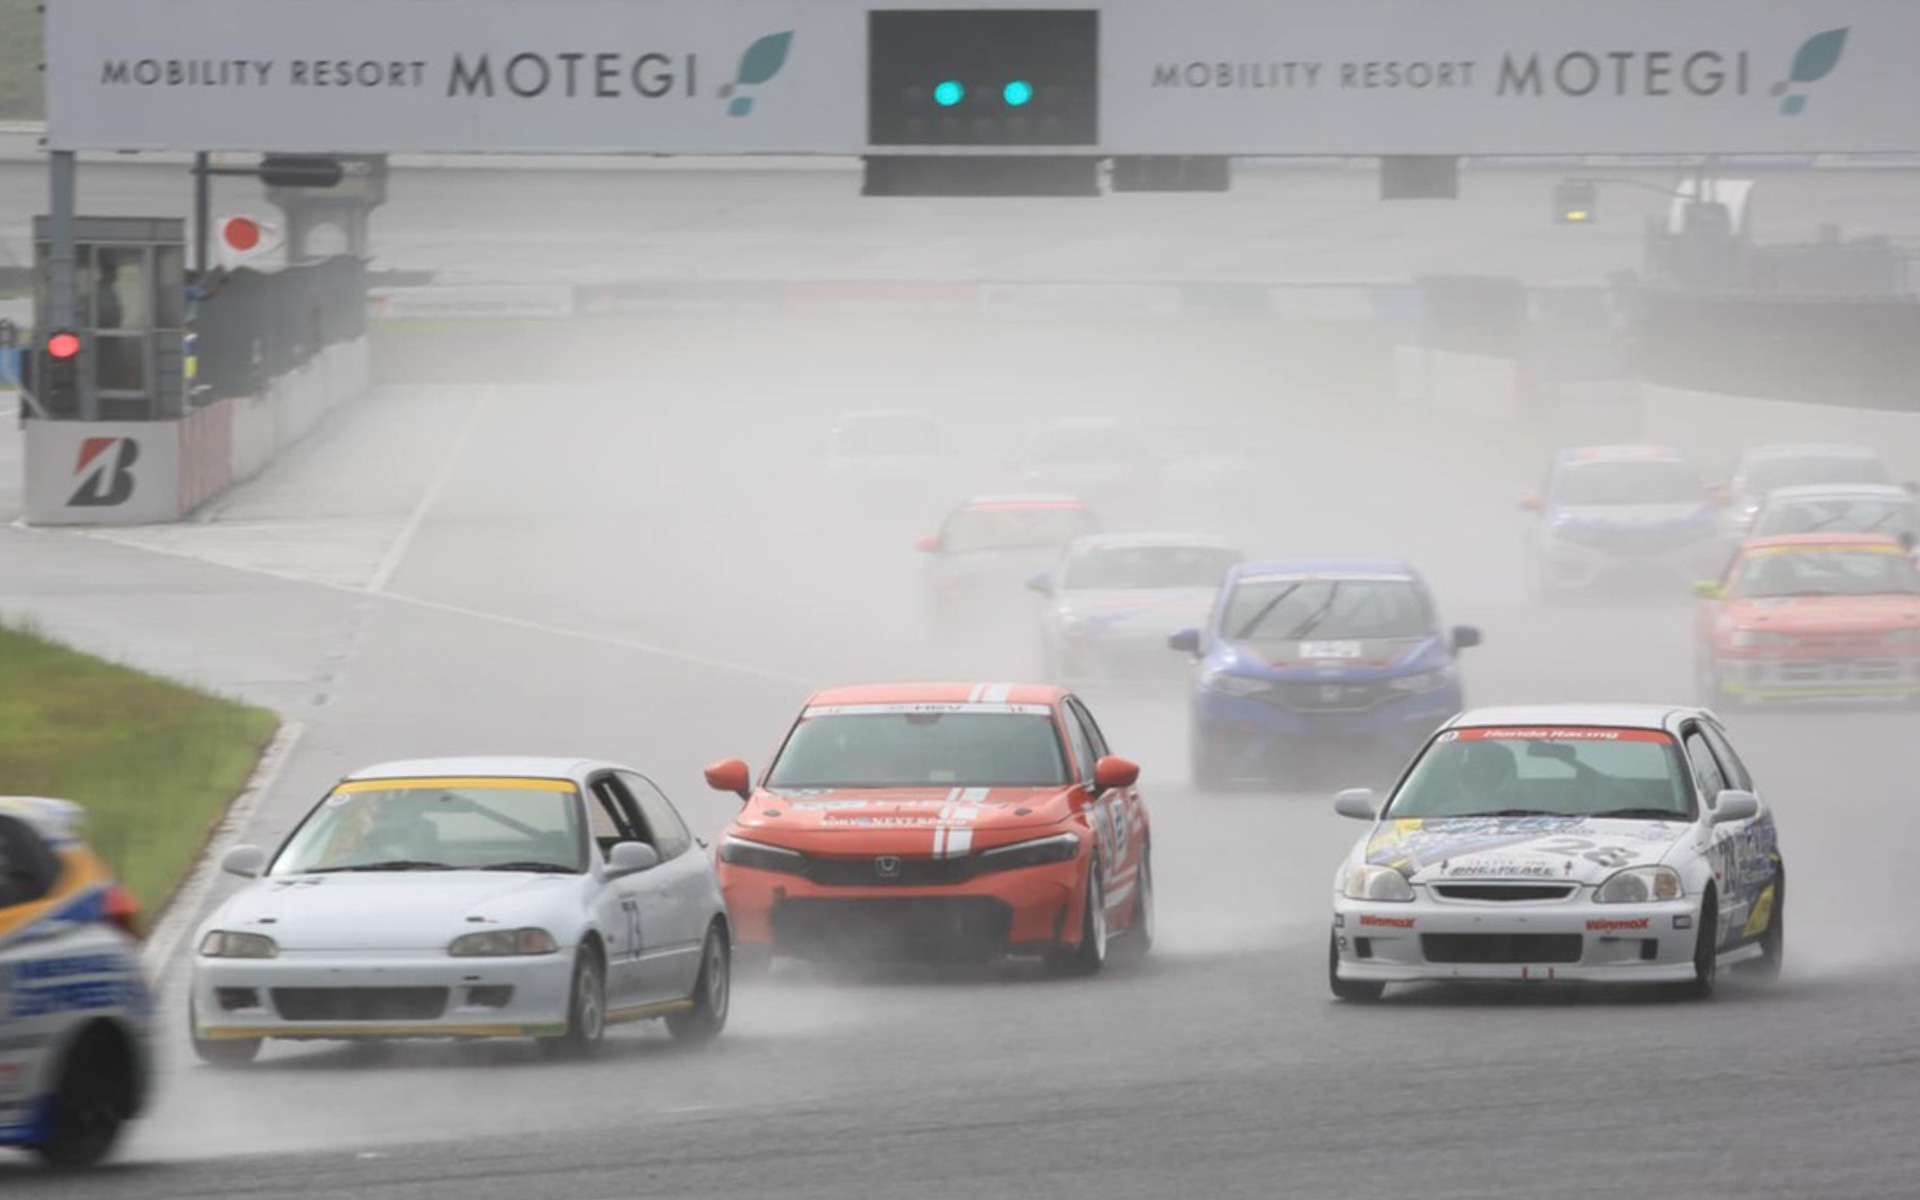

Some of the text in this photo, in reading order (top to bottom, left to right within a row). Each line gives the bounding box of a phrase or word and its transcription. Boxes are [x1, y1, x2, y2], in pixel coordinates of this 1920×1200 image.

[101, 53, 697, 98] MOBILITY RESORT MOTEGI
[1152, 51, 1749, 97] MOBILITY RESORT MOTEGI
